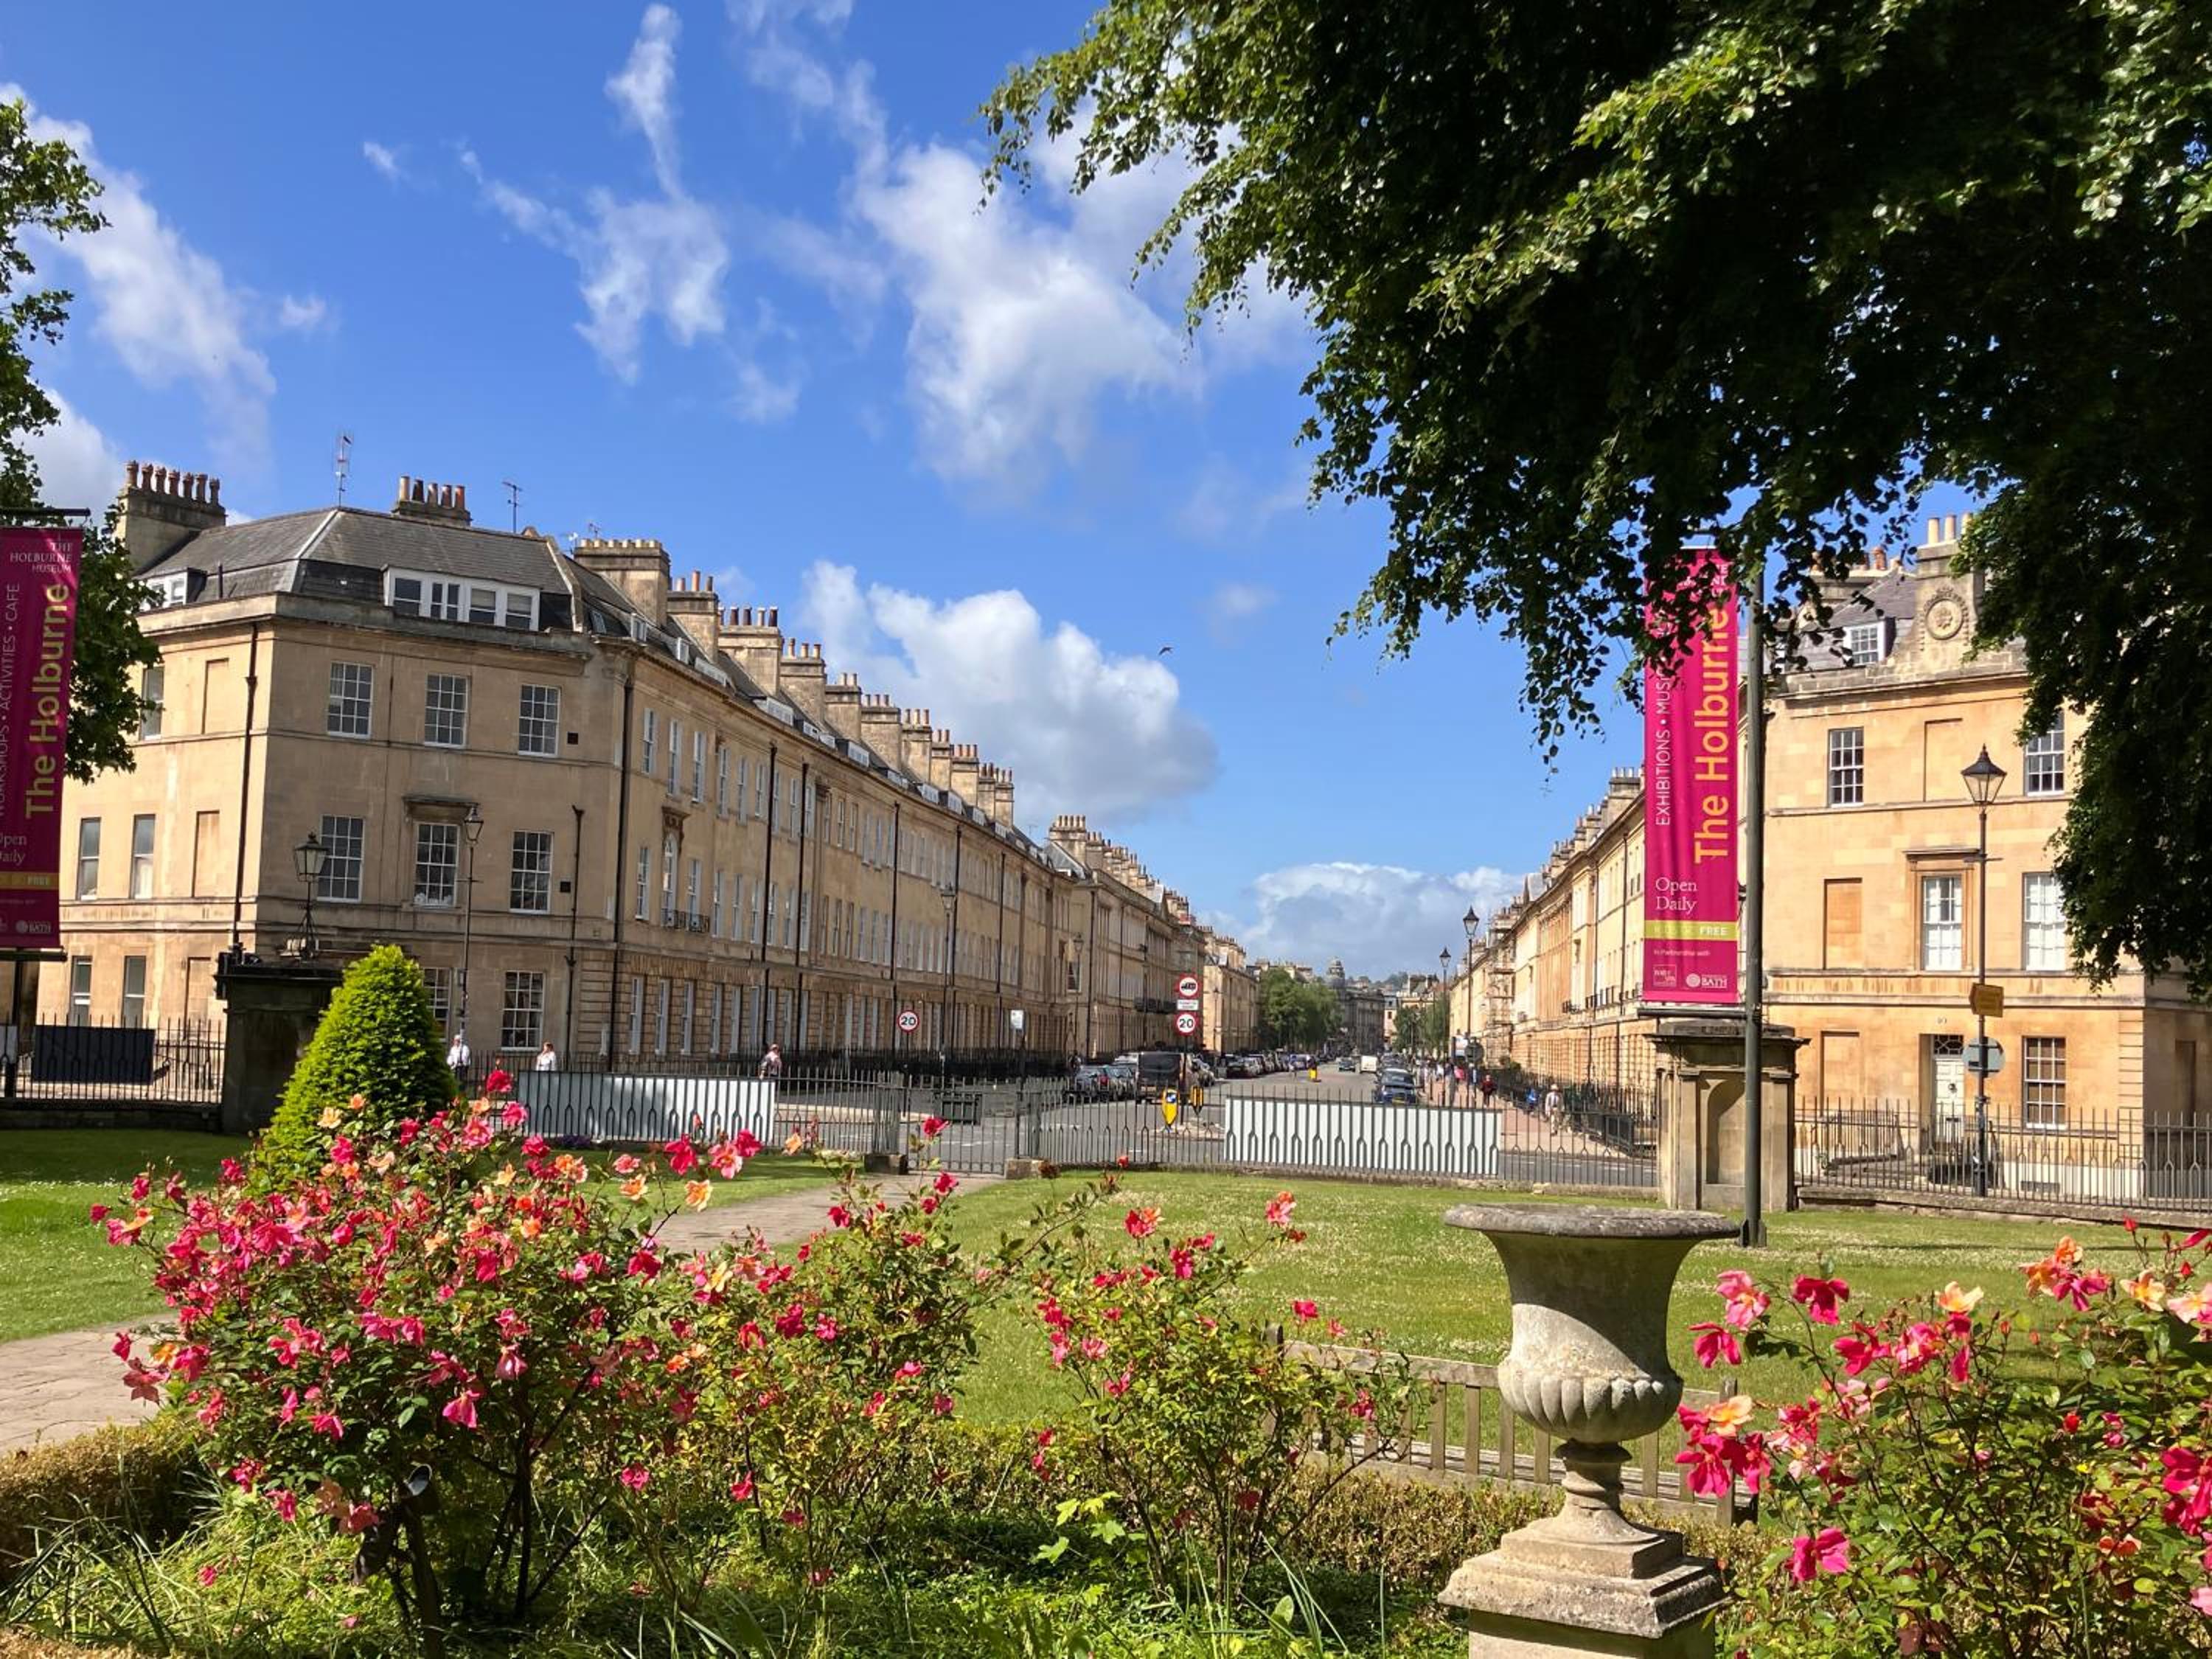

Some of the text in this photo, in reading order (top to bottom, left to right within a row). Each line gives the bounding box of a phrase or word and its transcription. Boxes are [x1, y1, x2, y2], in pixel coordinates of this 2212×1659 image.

[49, 542, 72, 552] THE
[10, 552, 72, 563] HOLBURNE
[32, 563, 72, 574] MUSEUM
[5, 583, 20, 622] CAFE
[0, 634, 15, 710] ACTIVITIES
[26, 584, 69, 818] The Holburne
[1694, 608, 1728, 781] Holburne
[1656, 729, 1670, 826] EXHIBITIONS
[1694, 795, 1729, 863] The
[0, 832, 27, 847] pen
[0, 849, 25, 866] aily
[1655, 877, 1697, 895] Open
[1656, 896, 1697, 914] Daily
[1700, 926, 1728, 936] FREE
[1702, 977, 1728, 987] BATH
[901, 1016, 916, 1026] 20
[1179, 1018, 1194, 1029] 20
